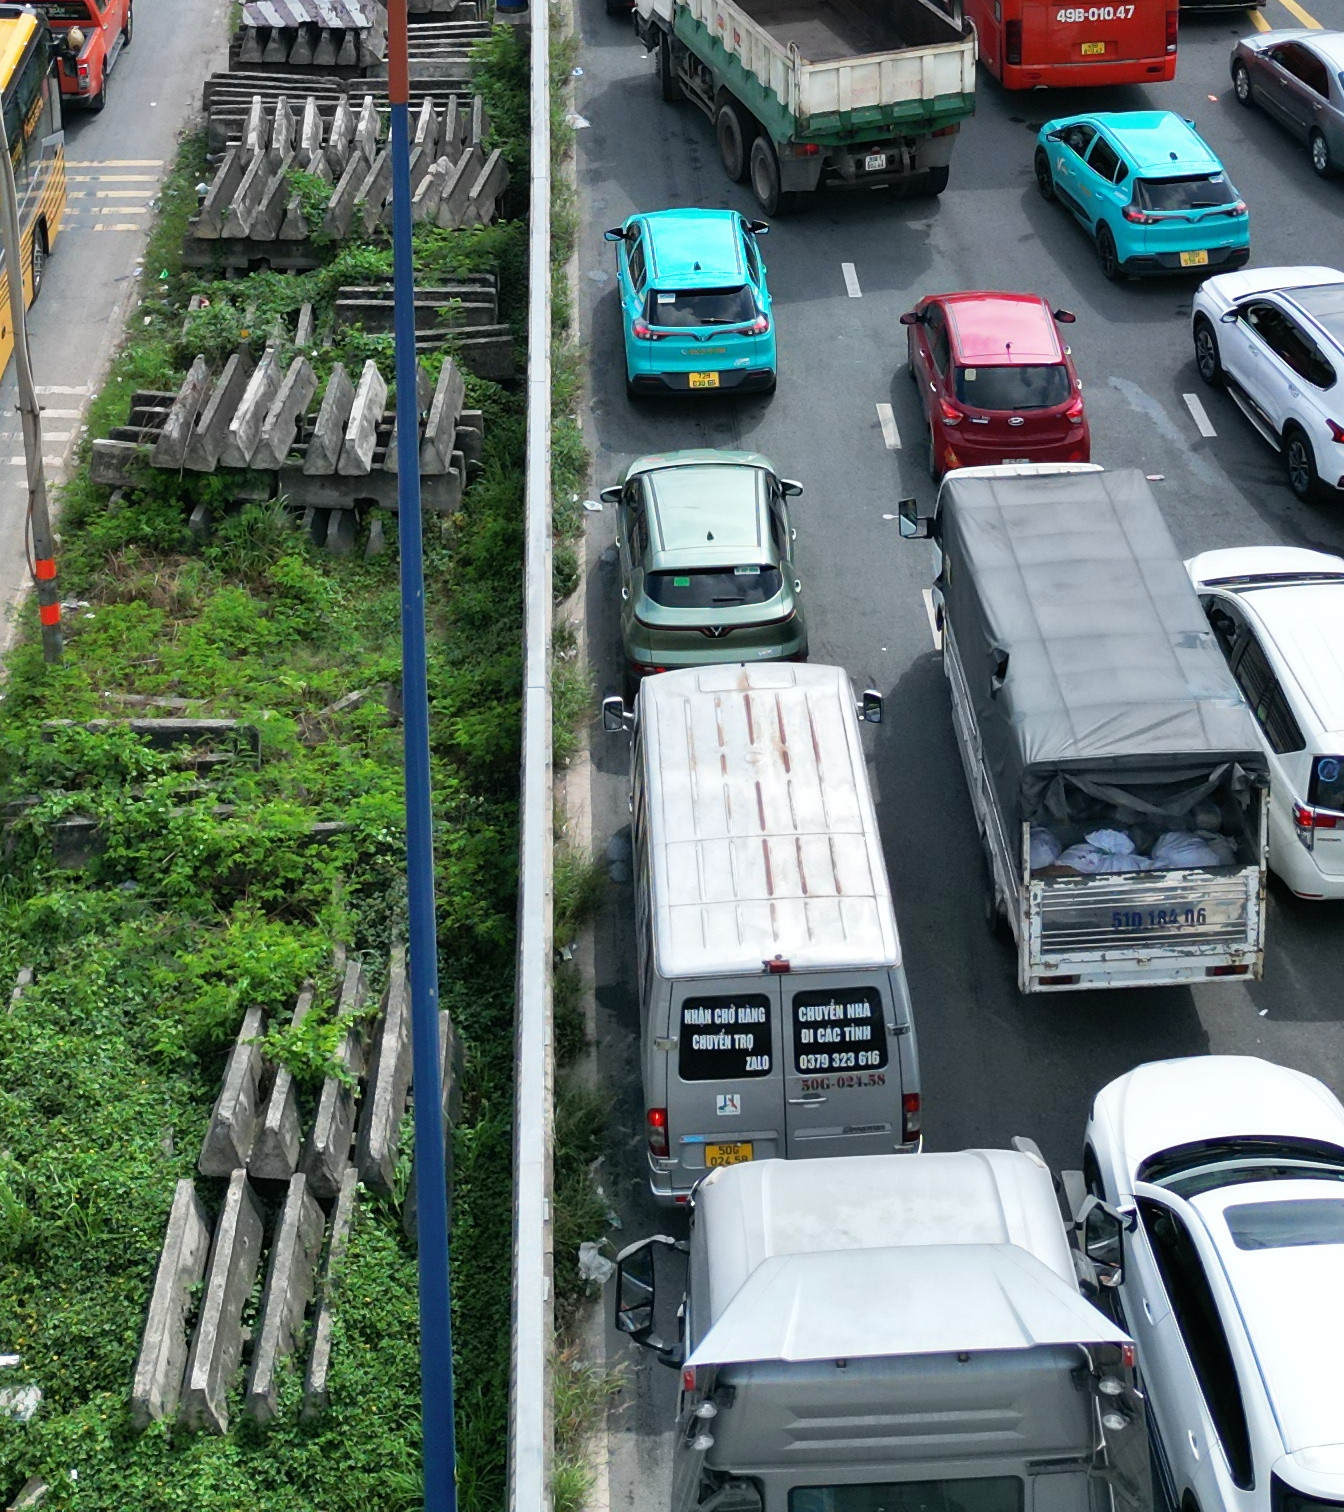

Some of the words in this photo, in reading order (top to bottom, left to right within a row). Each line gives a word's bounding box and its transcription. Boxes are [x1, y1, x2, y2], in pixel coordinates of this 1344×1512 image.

[1056, 4, 1135, 23] 49B-010.47
[684, 1006, 712, 1028] NHẬN
[714, 1003, 736, 1025] CHỞ
[738, 1005, 766, 1024] HÀNG
[847, 997, 871, 1018] NHÀ
[733, 1033, 754, 1052] TRỌ
[801, 1029, 814, 1044] ĐI
[816, 1024, 841, 1043] CÁC
[745, 1055, 770, 1071] ZALO
[799, 1054, 829, 1070] 0379
[832, 1052, 856, 1068] 323
[858, 1050, 880, 1066] 616
[801, 1073, 886, 1092] 50G-024.58
[718, 1145, 740, 1156] 50G
